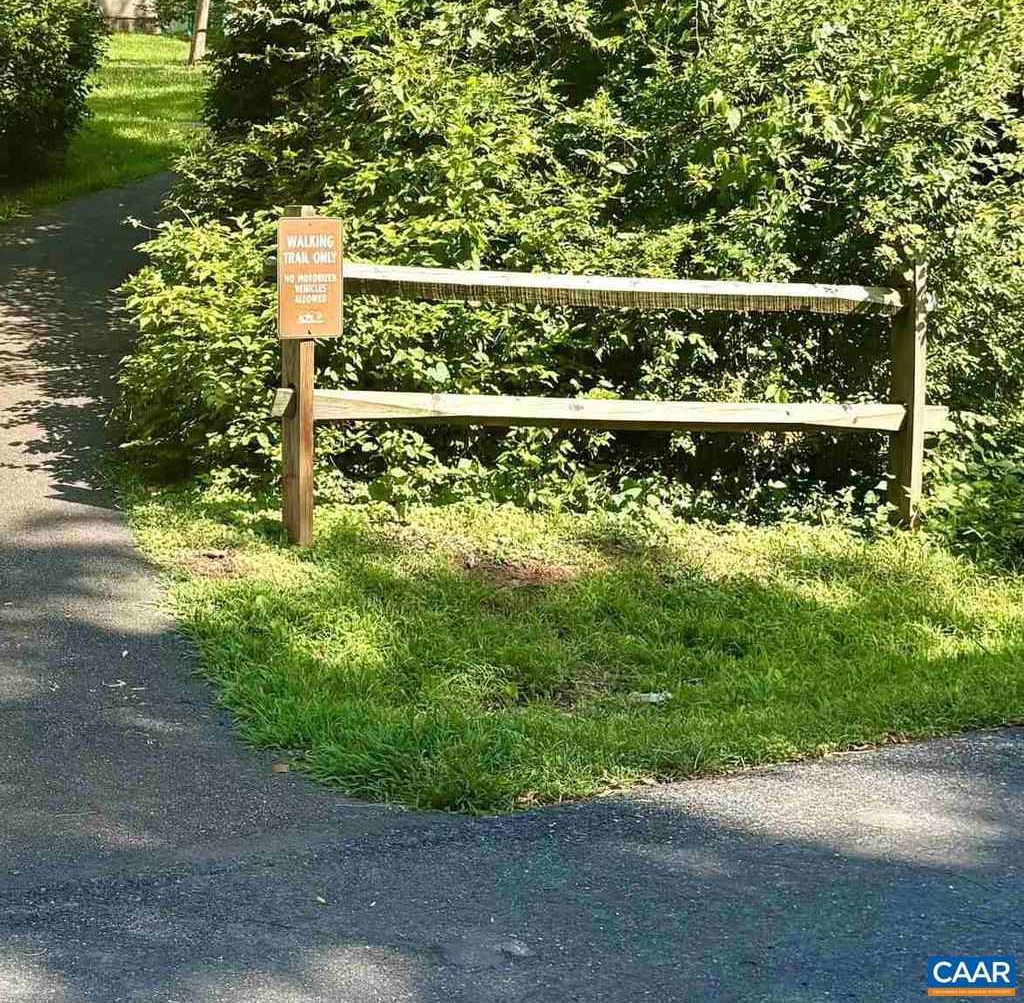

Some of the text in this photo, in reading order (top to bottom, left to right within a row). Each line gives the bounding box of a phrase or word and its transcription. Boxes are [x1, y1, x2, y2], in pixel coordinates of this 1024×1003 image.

[286, 235, 334, 248] WALKING
[283, 251, 336, 263] TRAIL ONLY
[284, 274, 294, 283] NO
